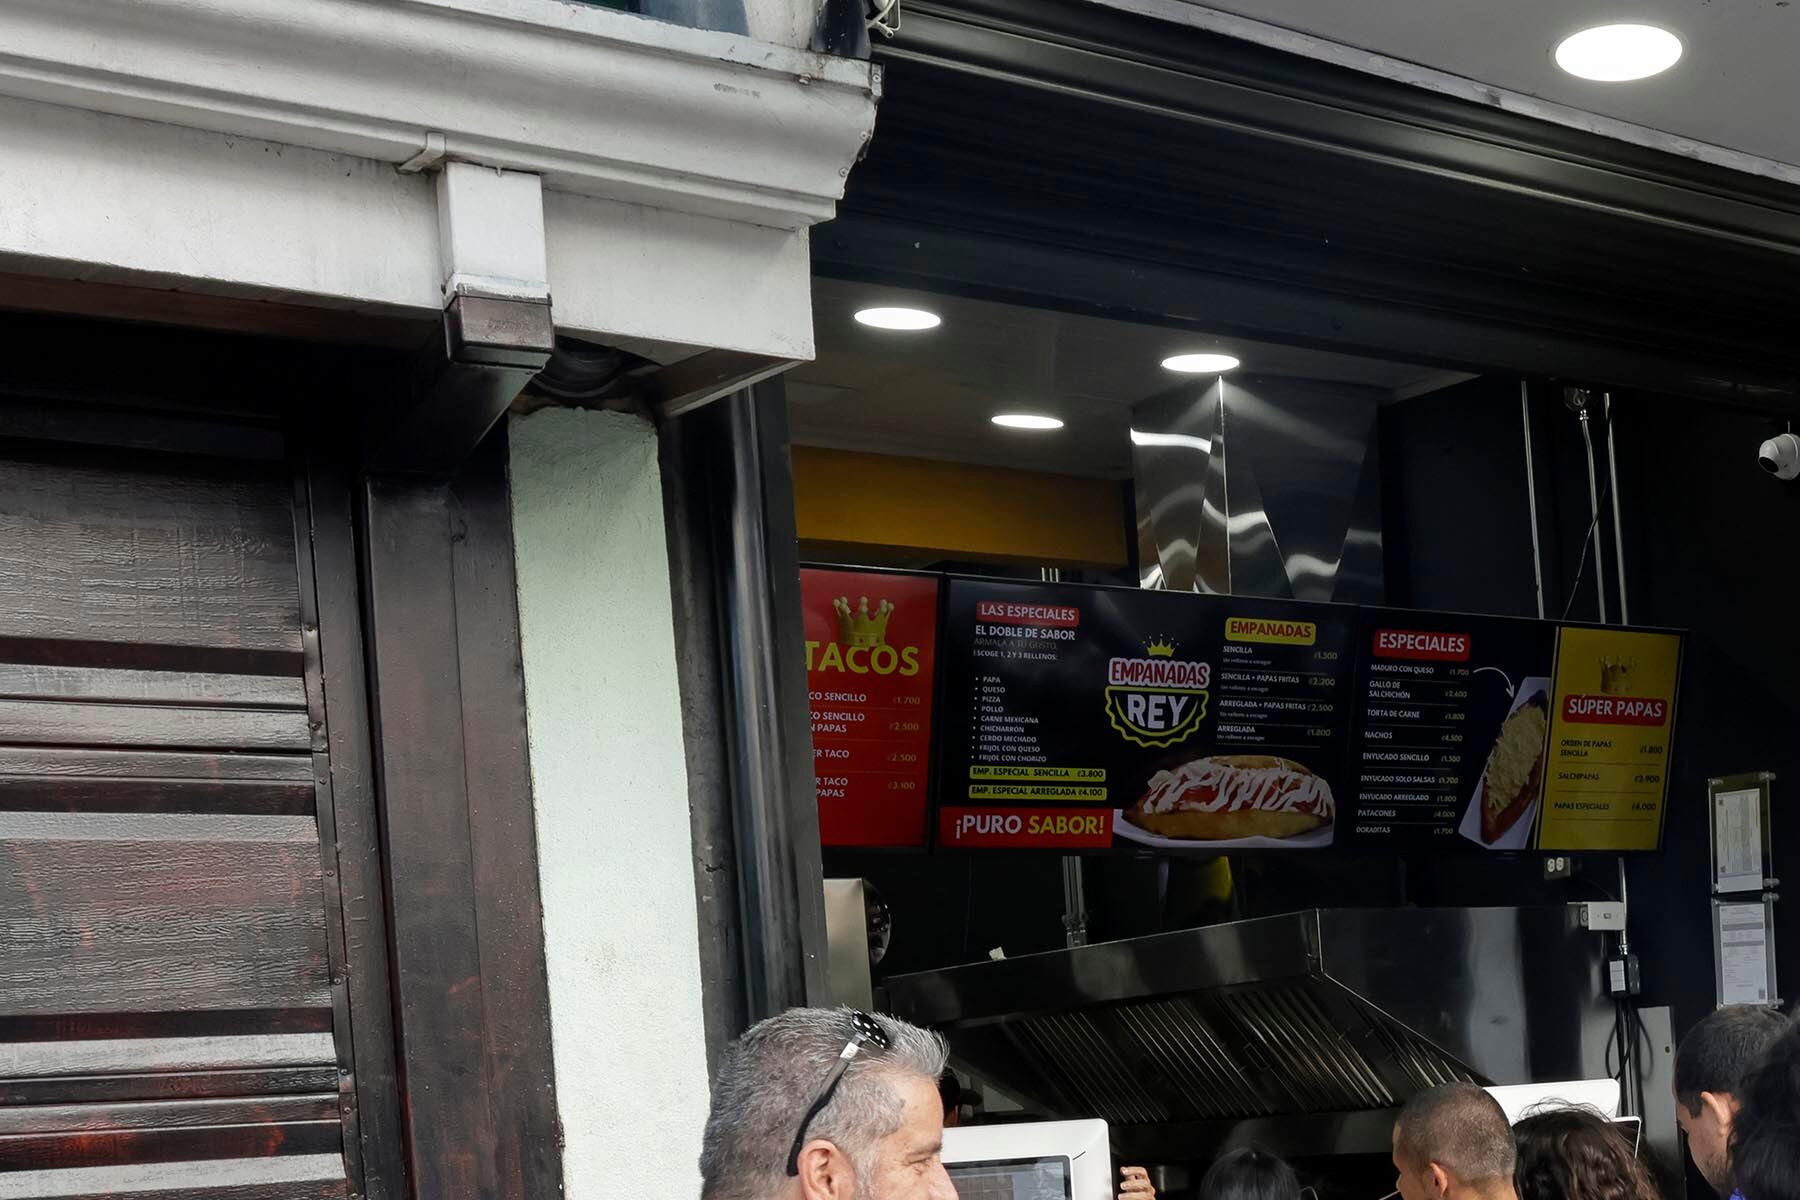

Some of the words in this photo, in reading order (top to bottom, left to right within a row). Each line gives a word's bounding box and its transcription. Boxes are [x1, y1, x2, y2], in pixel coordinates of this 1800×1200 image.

[981, 604, 1004, 617] LAS
[1007, 606, 1075, 621] ESPECIALES
[975, 625, 987, 636] EL
[989, 625, 1023, 638] DOBLE
[1025, 627, 1038, 638] DE
[1040, 628, 1075, 641] SABOR
[1230, 621, 1312, 638] EMPANADAS
[1379, 632, 1465, 653] ESPECIALES
[973, 649, 998, 657] ESCOGE
[1222, 645, 1253, 654] SENCILLA
[805, 640, 920, 677] TACOS
[1110, 659, 1209, 687] EMPANADAS
[1370, 664, 1398, 672] MADURO
[1398, 665, 1412, 673] CON
[1413, 667, 1434, 675] QUESO
[983, 676, 1001, 684] PAPA
[1221, 673, 1250, 681] SENCILLA
[1256, 674, 1277, 683] PAPAS
[1369, 680, 1392, 688] GALLO
[1392, 681, 1401, 689] DE
[982, 686, 1006, 694] QUESO
[824, 691, 867, 703] SENCILLO
[1219, 700, 1258, 708] ARREGLADA
[1263, 701, 1284, 709] PAPAS
[1285, 702, 1306, 711] FRITAS
[1568, 695, 1613, 716] SÚPER
[1616, 700, 1663, 718] PAPAS
[1127, 693, 1189, 729] REY
[1367, 709, 1388, 717] TORTA
[1398, 710, 1420, 719] CARNE
[822, 711, 865, 722] SENCILLO
[980, 715, 1003, 723] CARNE
[1004, 716, 1039, 724] MEXICANA
[817, 724, 847, 734] PAPAS
[1217, 726, 1255, 734] ARREGLADA
[1364, 731, 1393, 740] NACHOS
[979, 744, 1001, 753] FRIJOL
[1002, 745, 1017, 753] CON
[1018, 746, 1041, 754] QUESO
[1592, 740, 1611, 748] PAPAS
[824, 749, 850, 759] TACO
[978, 754, 1000, 762] FRIJOL
[1017, 755, 1047, 763] CHORIZO
[1362, 752, 1398, 761] ENYUCADO
[1399, 753, 1430, 762] SENCILLO
[973, 767, 991, 776] EMP.
[993, 767, 1030, 777] ESPECIAL
[1033, 768, 1069, 777] SENCILLA
[823, 777, 848, 787] TACO
[1395, 775, 1411, 783] SOLO
[972, 786, 991, 795] EMP.
[993, 786, 1028, 795] ESPECIAL
[1030, 787, 1077, 797] ARREGLADA
[1359, 793, 1392, 801] ENYUCADO
[1357, 809, 1396, 817] PATACONES
[955, 815, 1022, 839] ¡PURO
[1027, 815, 1104, 835] SABOR!
[1356, 826, 1391, 834] DORADITAS
